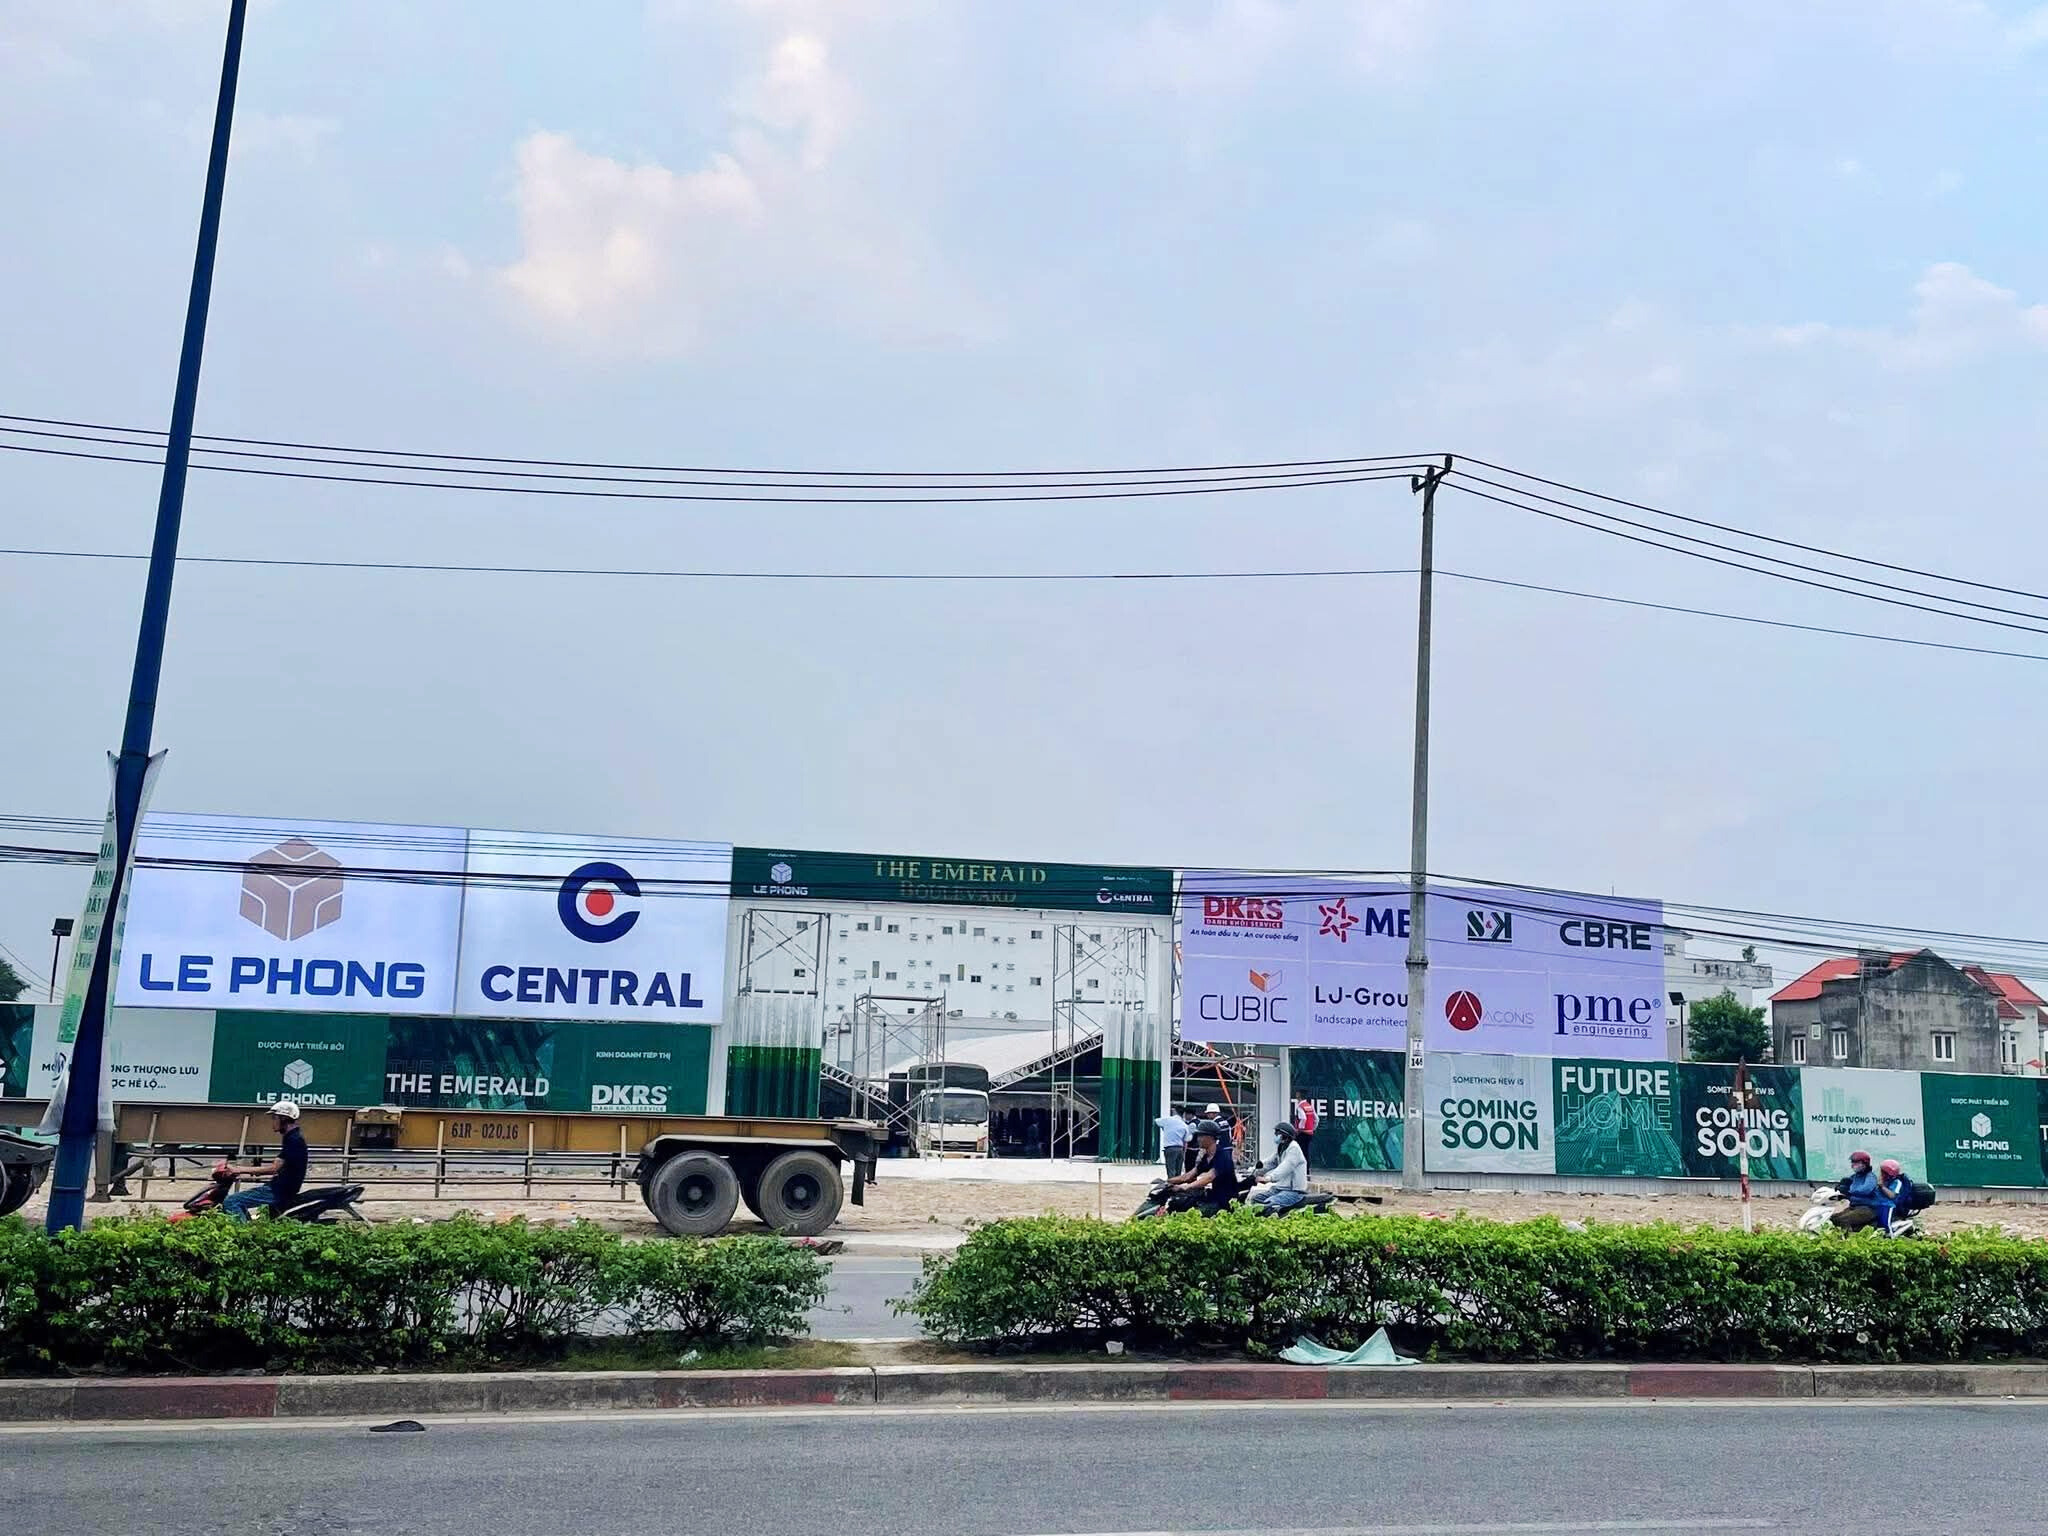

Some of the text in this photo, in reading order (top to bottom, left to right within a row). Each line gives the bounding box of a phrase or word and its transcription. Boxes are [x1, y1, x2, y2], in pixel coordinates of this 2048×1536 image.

[874, 860, 1047, 884] THE EMERALD
[753, 885, 808, 896] LE PHONG
[1113, 894, 1154, 903] CENTRAL
[1204, 896, 1283, 920] DKRS
[1251, 920, 1281, 928] SERVICE
[1559, 920, 1652, 951] CBRE
[140, 953, 213, 992] LE
[230, 956, 425, 999] PHONG
[480, 965, 704, 1008] CENTRAL
[1315, 985, 1409, 1008] LJ-Grou
[1200, 994, 1288, 1024] CUBIC
[1482, 1009, 1535, 1025] ACONS
[1315, 1014, 1363, 1025] landscape
[1573, 1023, 1648, 1038] engineering
[284, 1041, 304, 1049] PHÁT
[596, 1051, 614, 1059] KINH
[615, 1051, 641, 1059] DOANH
[658, 1051, 671, 1061] THỊ
[180, 1066, 200, 1075] LƯU
[386, 1073, 550, 1097] THE EMERALD
[1452, 1076, 1524, 1086] SOMETHING NEW IS
[1561, 1066, 1671, 1096] FUTURE
[256, 1092, 336, 1105] LE PHONG
[592, 1084, 668, 1105] DKRS
[1767, 1088, 1775, 1096] IS
[1334, 1099, 1405, 1119] EMERAL
[1440, 1098, 1538, 1120] COMING
[1561, 1094, 1673, 1131] HOME
[1696, 1107, 1789, 1130] COMING
[452, 1122, 472, 1139] 61R
[481, 1123, 519, 1140] 020.16
[1441, 1119, 1539, 1151] SOON
[1697, 1127, 1791, 1158] SOON
[1956, 1139, 2009, 1151] LE PHONG
